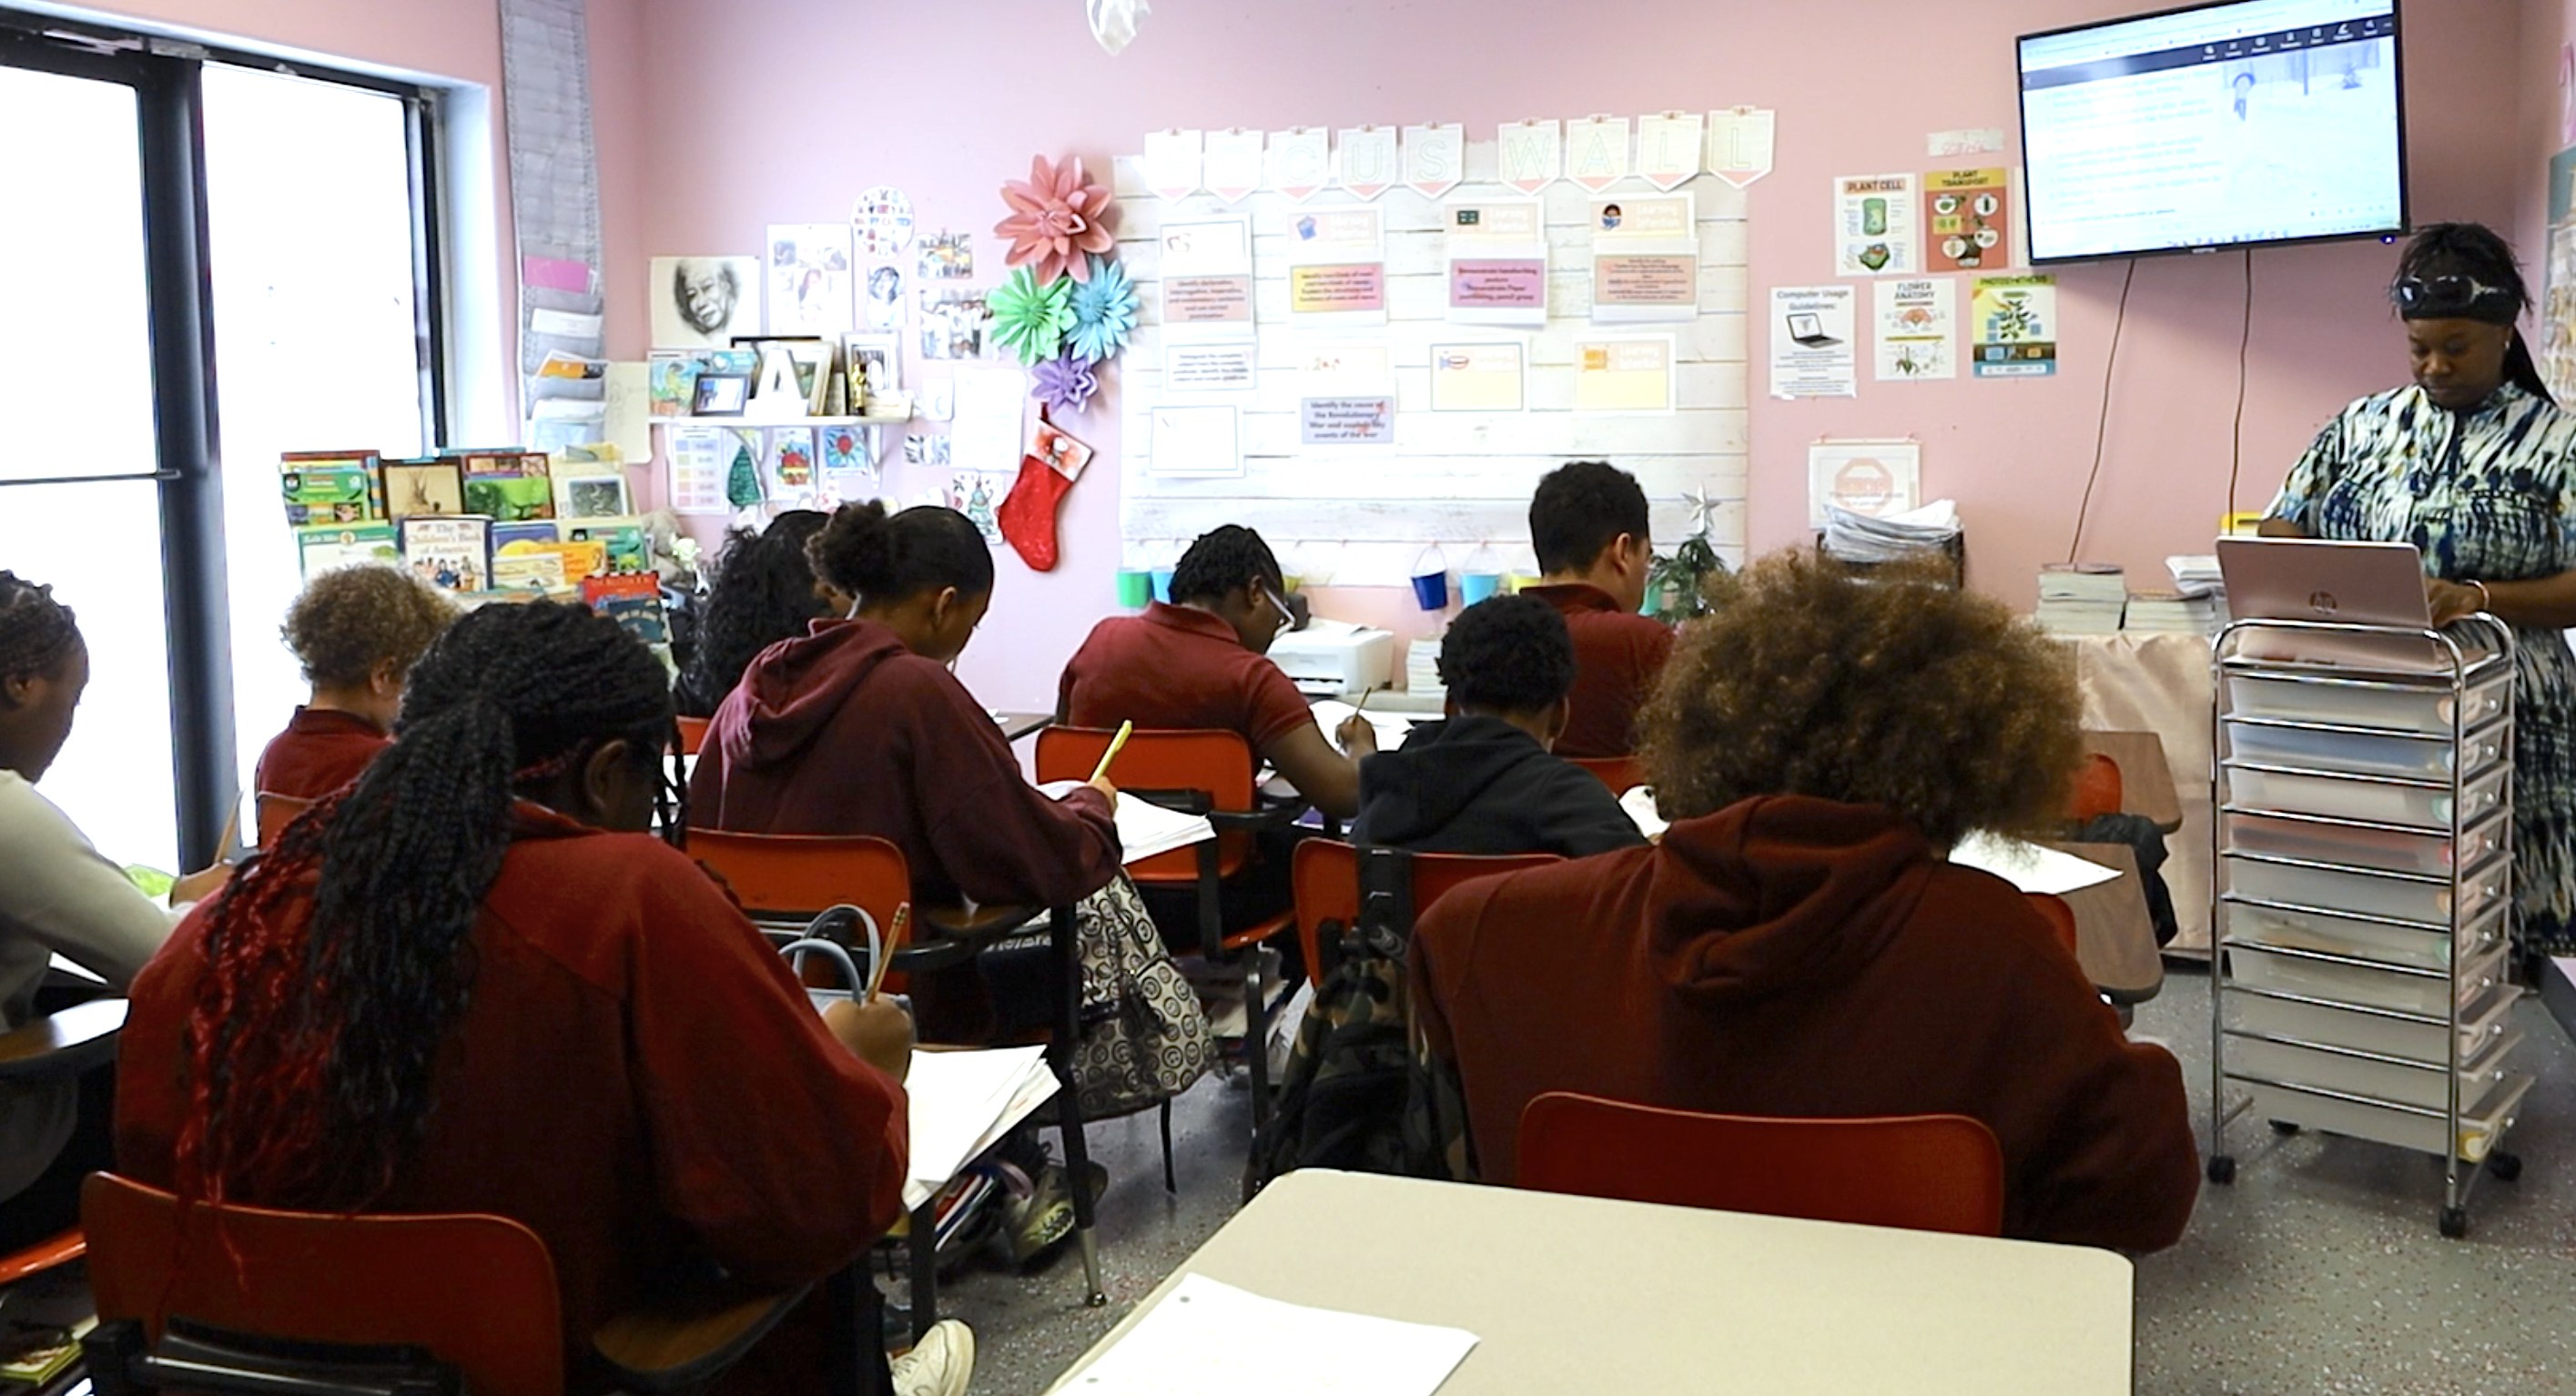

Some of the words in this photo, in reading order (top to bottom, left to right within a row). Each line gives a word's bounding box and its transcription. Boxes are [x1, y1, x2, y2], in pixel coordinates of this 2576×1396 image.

[1162, 139, 1449, 182] OCUS
[1506, 127, 1752, 181] WALL
[1848, 181, 1878, 192] PLANT
[1879, 180, 1902, 190] CELL
[1897, 282, 1932, 290] FLOWER
[1777, 290, 1820, 298] Computer
[1821, 289, 1849, 298] Usage
[1894, 291, 1935, 299] ANATOMY
[1311, 401, 1338, 410] Identify
[1329, 411, 1379, 420] Revolutionary
[435, 523, 453, 532] The
[408, 533, 456, 544] Children's
[458, 532, 482, 542] Book
[432, 545, 472, 553] America
[2309, 592, 2337, 614] hp
